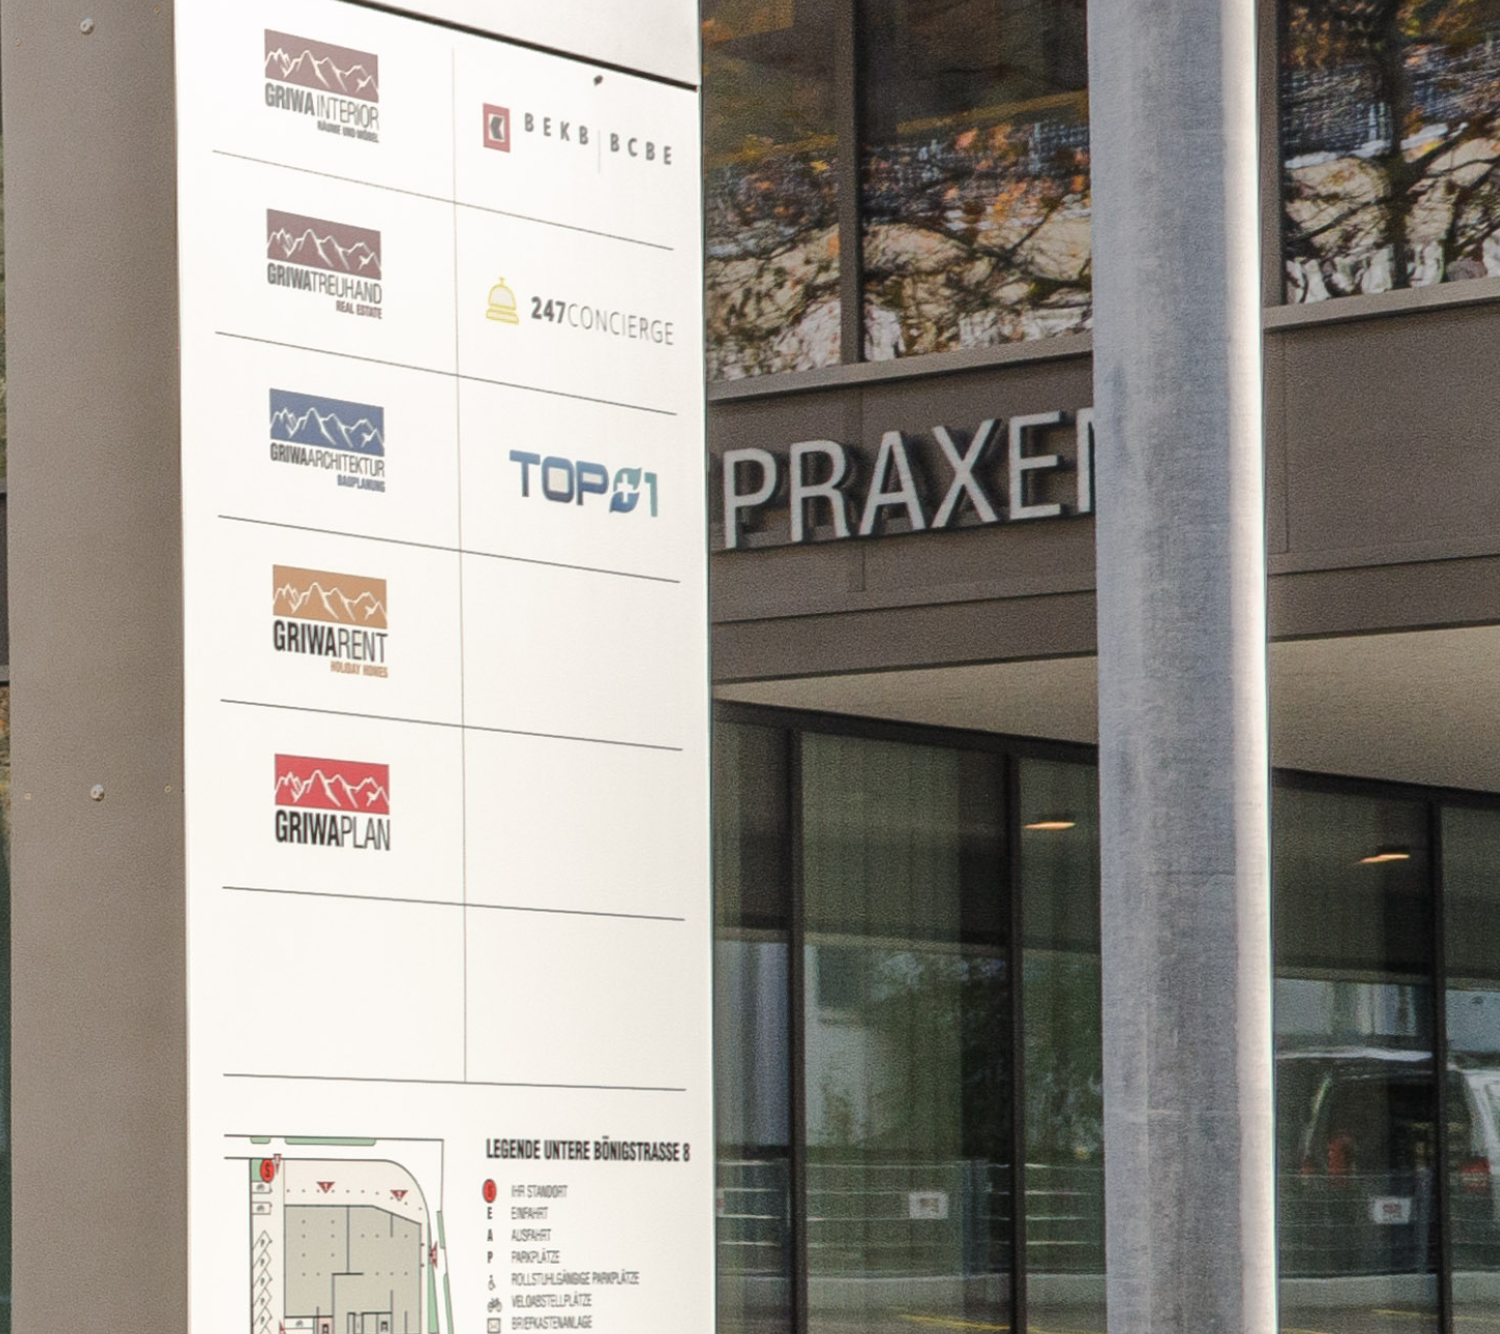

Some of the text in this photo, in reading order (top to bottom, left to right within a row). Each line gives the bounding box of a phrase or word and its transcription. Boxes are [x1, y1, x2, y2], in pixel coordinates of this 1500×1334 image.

[265, 82, 380, 130] GRIWA INTERIOR
[524, 112, 672, 165] BEKB BCBE
[267, 262, 382, 305] GRIWATREUHAND
[336, 300, 382, 319] REAL ESTATE
[531, 295, 674, 346] 247CONCIERGE
[270, 442, 385, 478] GRIWAARCHITEKTUR
[273, 619, 388, 663] GRIWARENT
[274, 809, 390, 852] GRIWAPLAN
[486, 1135, 690, 1162] LEGENDE UNTERE BÖNIGSTRASSE 8
[527, 1185, 568, 1198] STANDORT
[487, 1207, 493, 1219] E
[487, 1229, 493, 1242] A
[487, 1251, 493, 1264] P
